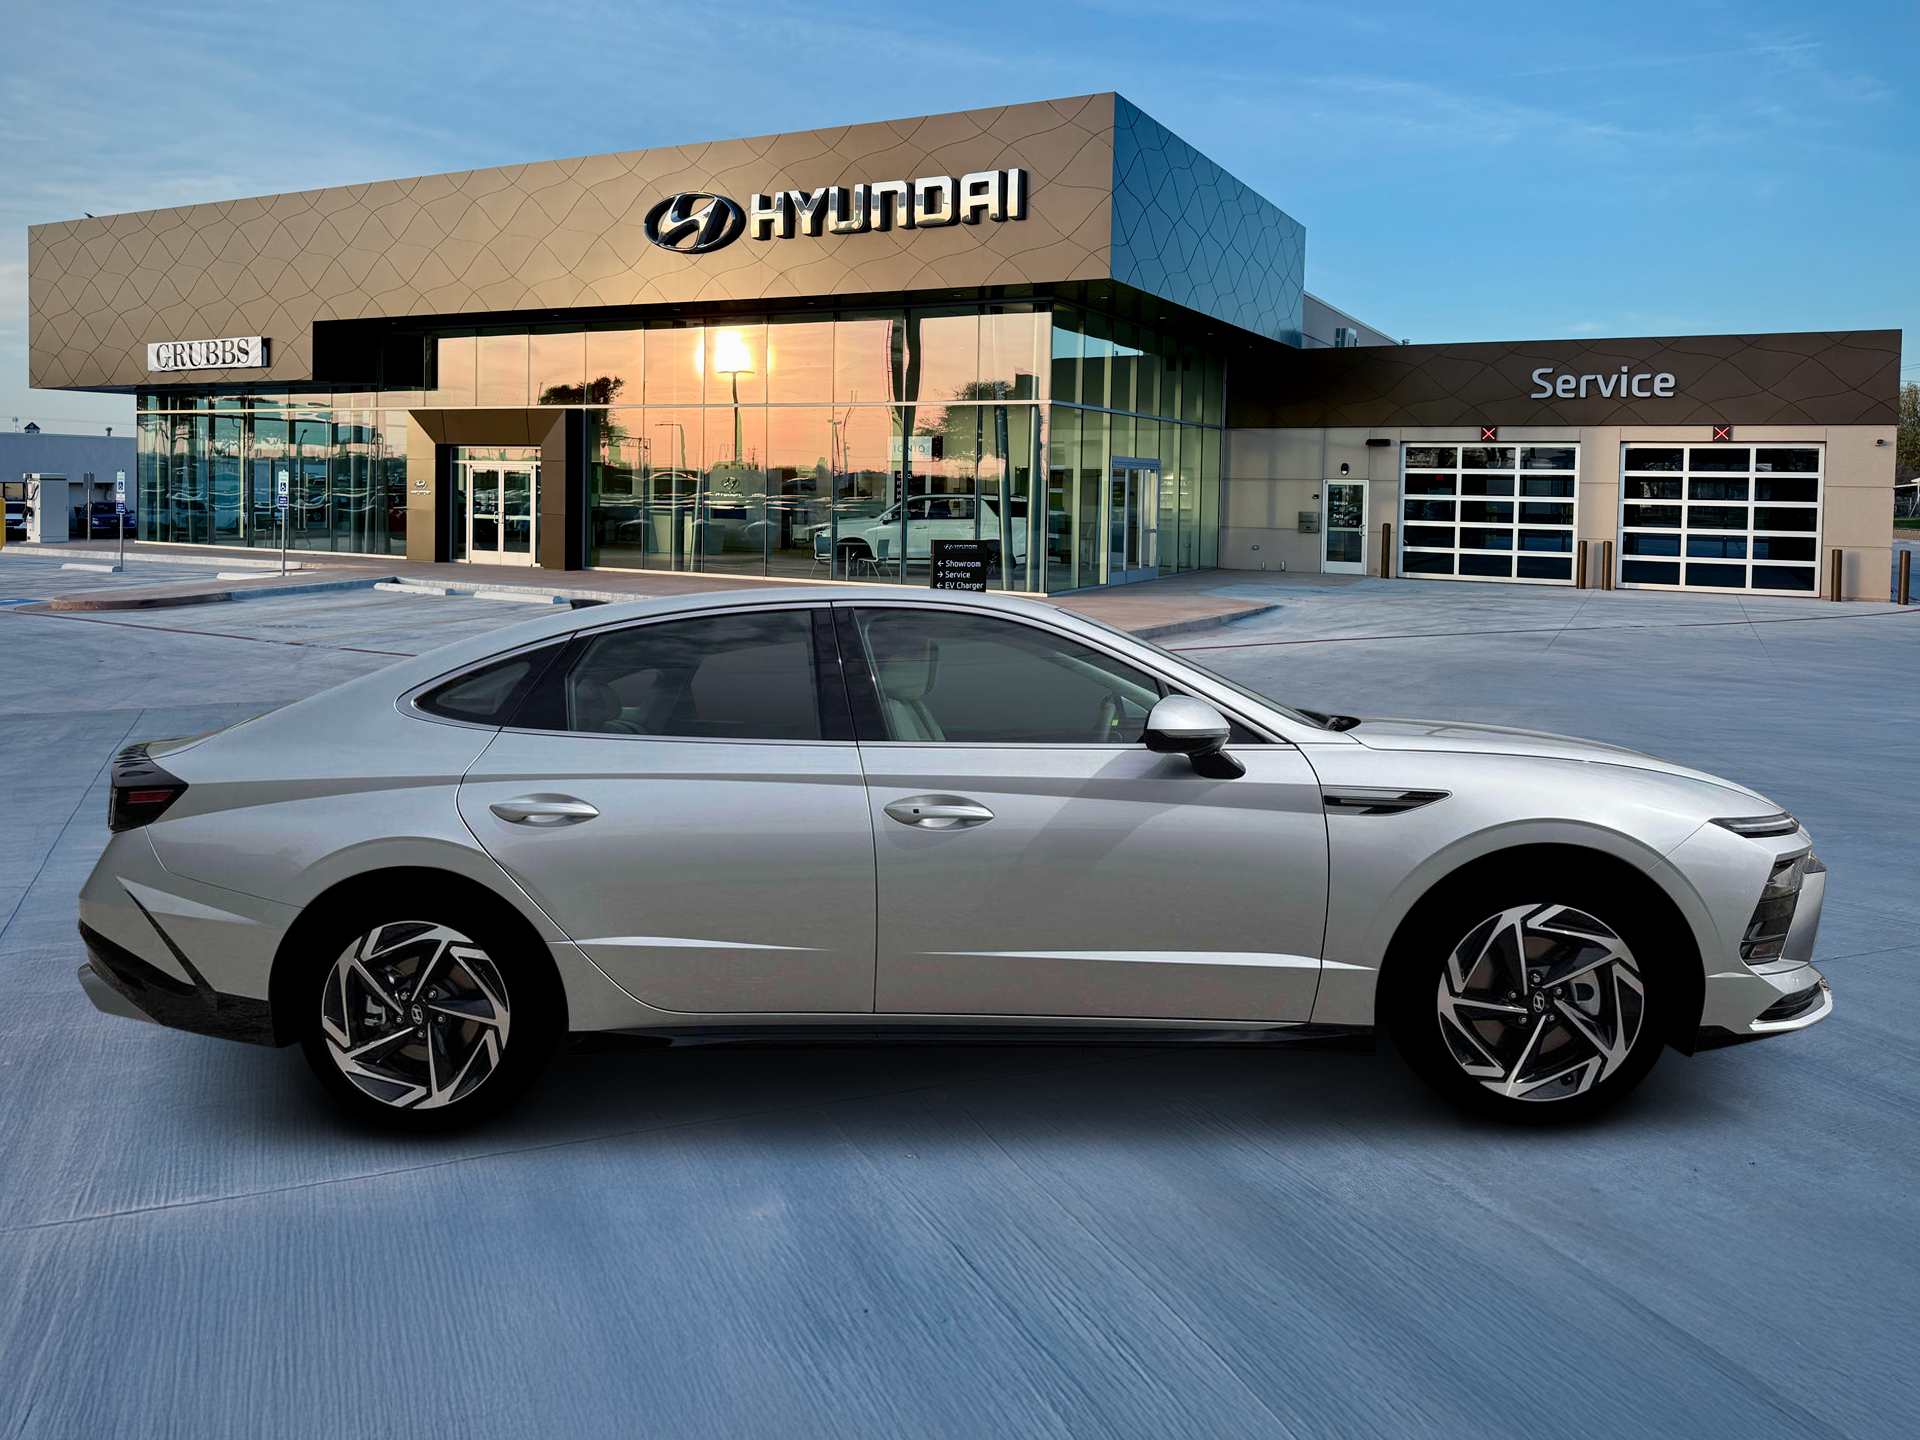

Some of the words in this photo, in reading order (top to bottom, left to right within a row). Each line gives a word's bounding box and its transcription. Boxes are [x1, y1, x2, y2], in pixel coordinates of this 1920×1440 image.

[751, 168, 1026, 240] HYUNDAI
[156, 338, 250, 368] GRUBBS
[1530, 365, 1676, 399] Service
[945, 559, 982, 568] Showroom
[945, 570, 971, 578] Service
[945, 581, 955, 589] EV
[956, 581, 984, 591] Charger
